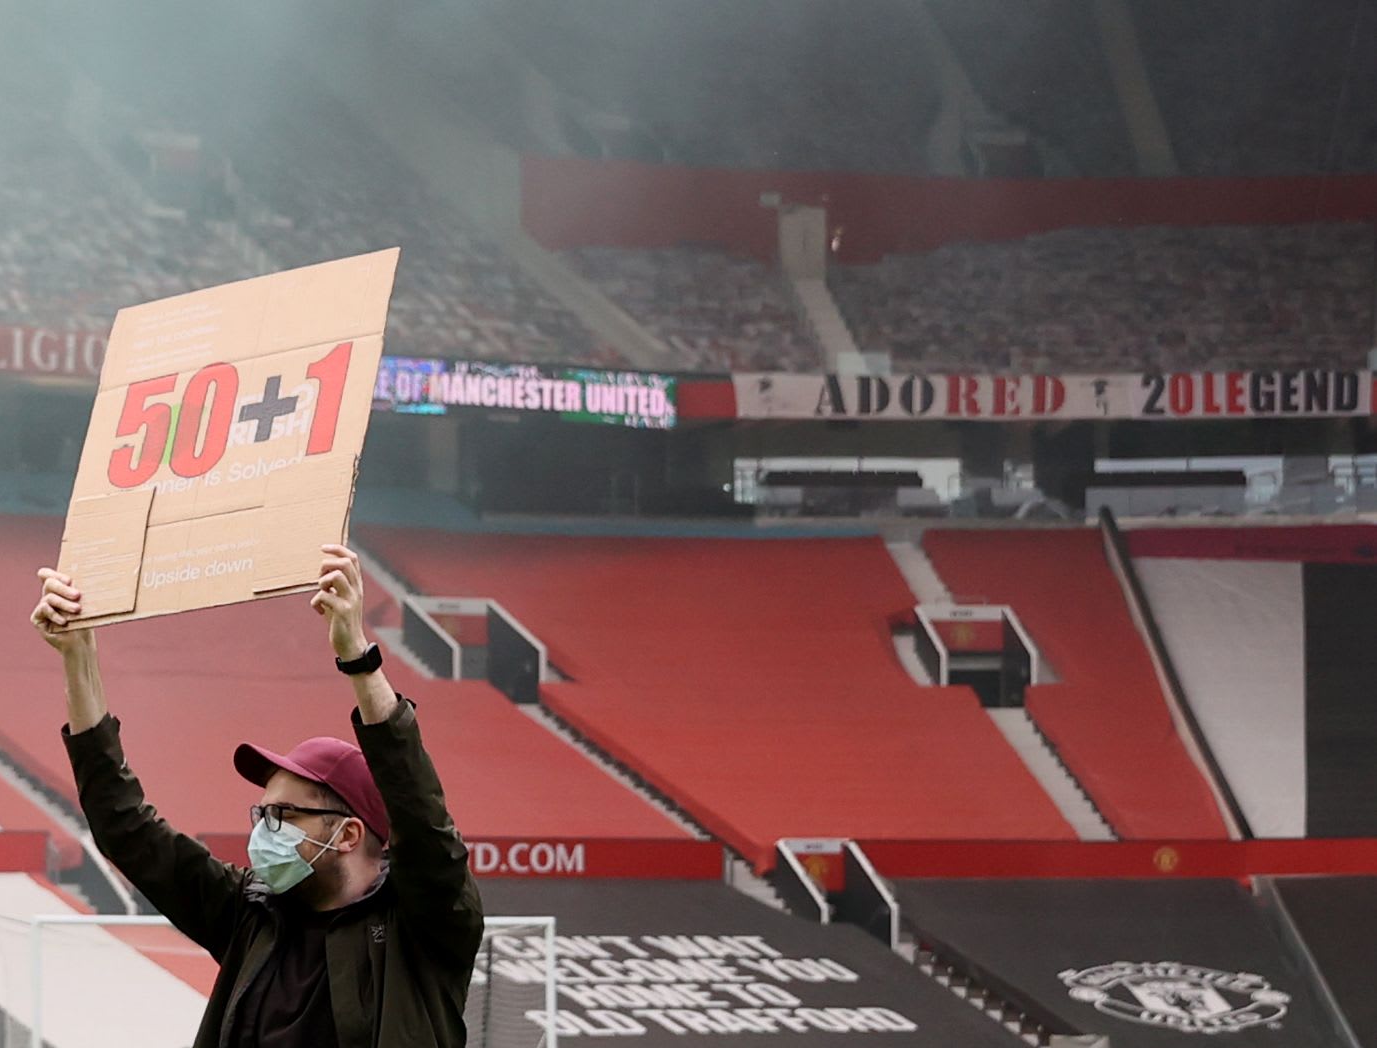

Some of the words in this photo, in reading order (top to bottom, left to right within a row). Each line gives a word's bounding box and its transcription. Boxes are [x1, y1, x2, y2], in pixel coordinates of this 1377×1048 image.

[428, 373, 582, 413] MANCHESTER
[585, 382, 668, 418] UNITED
[815, 373, 1066, 416] ADORED
[108, 342, 353, 489] 50+1
[142, 563, 201, 589] Upside
[205, 557, 254, 577] down
[640, 935, 783, 959] WAIT
[489, 957, 755, 984] WELCOME
[737, 957, 859, 983] YOU
[553, 983, 729, 1009] HOME
[710, 982, 802, 1007] TO
[524, 1008, 647, 1037] OLD
[633, 1006, 918, 1034] TRAFFORD
